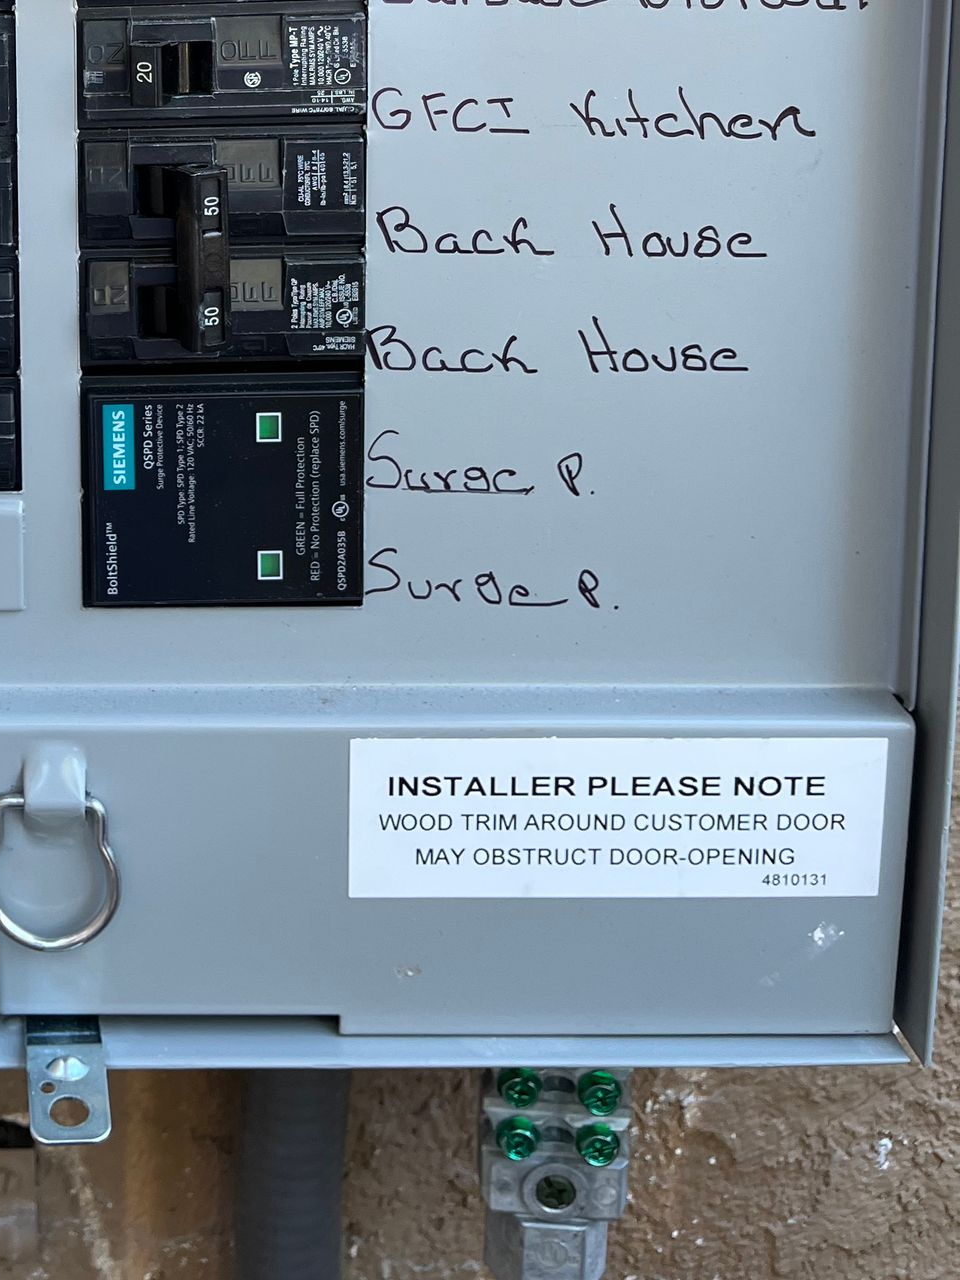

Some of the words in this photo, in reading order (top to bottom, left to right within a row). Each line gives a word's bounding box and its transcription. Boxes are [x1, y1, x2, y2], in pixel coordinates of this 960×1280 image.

[136, 61, 153, 84] 20
[370, 86, 531, 135] GFCI
[569, 86, 817, 141] Kitchen
[204, 195, 220, 217] 50
[591, 203, 768, 258] House
[204, 305, 220, 327] 50
[577, 315, 750, 374] House
[142, 404, 153, 437] Series
[155, 404, 163, 429] Device
[309, 410, 321, 436] SPD)
[111, 409, 127, 485] SIEMENS
[142, 439, 155, 470] QSPD
[155, 430, 164, 469] Protective
[310, 437, 322, 479] (replace
[339, 400, 347, 487] usa.siemens.com/surge
[295, 436, 305, 485] Protection
[156, 469, 166, 490] Surge
[295, 489, 305, 510] Full
[310, 480, 320, 532] Protection
[295, 522, 306, 556] GREEN
[310, 535, 320, 550] No
[310, 561, 320, 582] RED
[337, 530, 347, 591] QSPD2A035B
[364, 547, 570, 607] Surge
[387, 775, 577, 797] INSTALLER
[587, 775, 722, 797] PLEASE
[732, 775, 827, 796] NOTE
[378, 813, 453, 832] WOOD
[460, 813, 518, 832] TRIM
[523, 813, 627, 832] AROUND
[633, 812, 768, 832] CUSTOMER
[775, 812, 847, 831] DOOR
[414, 847, 466, 866] MAY
[472, 847, 603, 866] OBSTRUCT
[608, 847, 796, 866] DOOR-OPENING
[760, 873, 828, 887] 4810131
